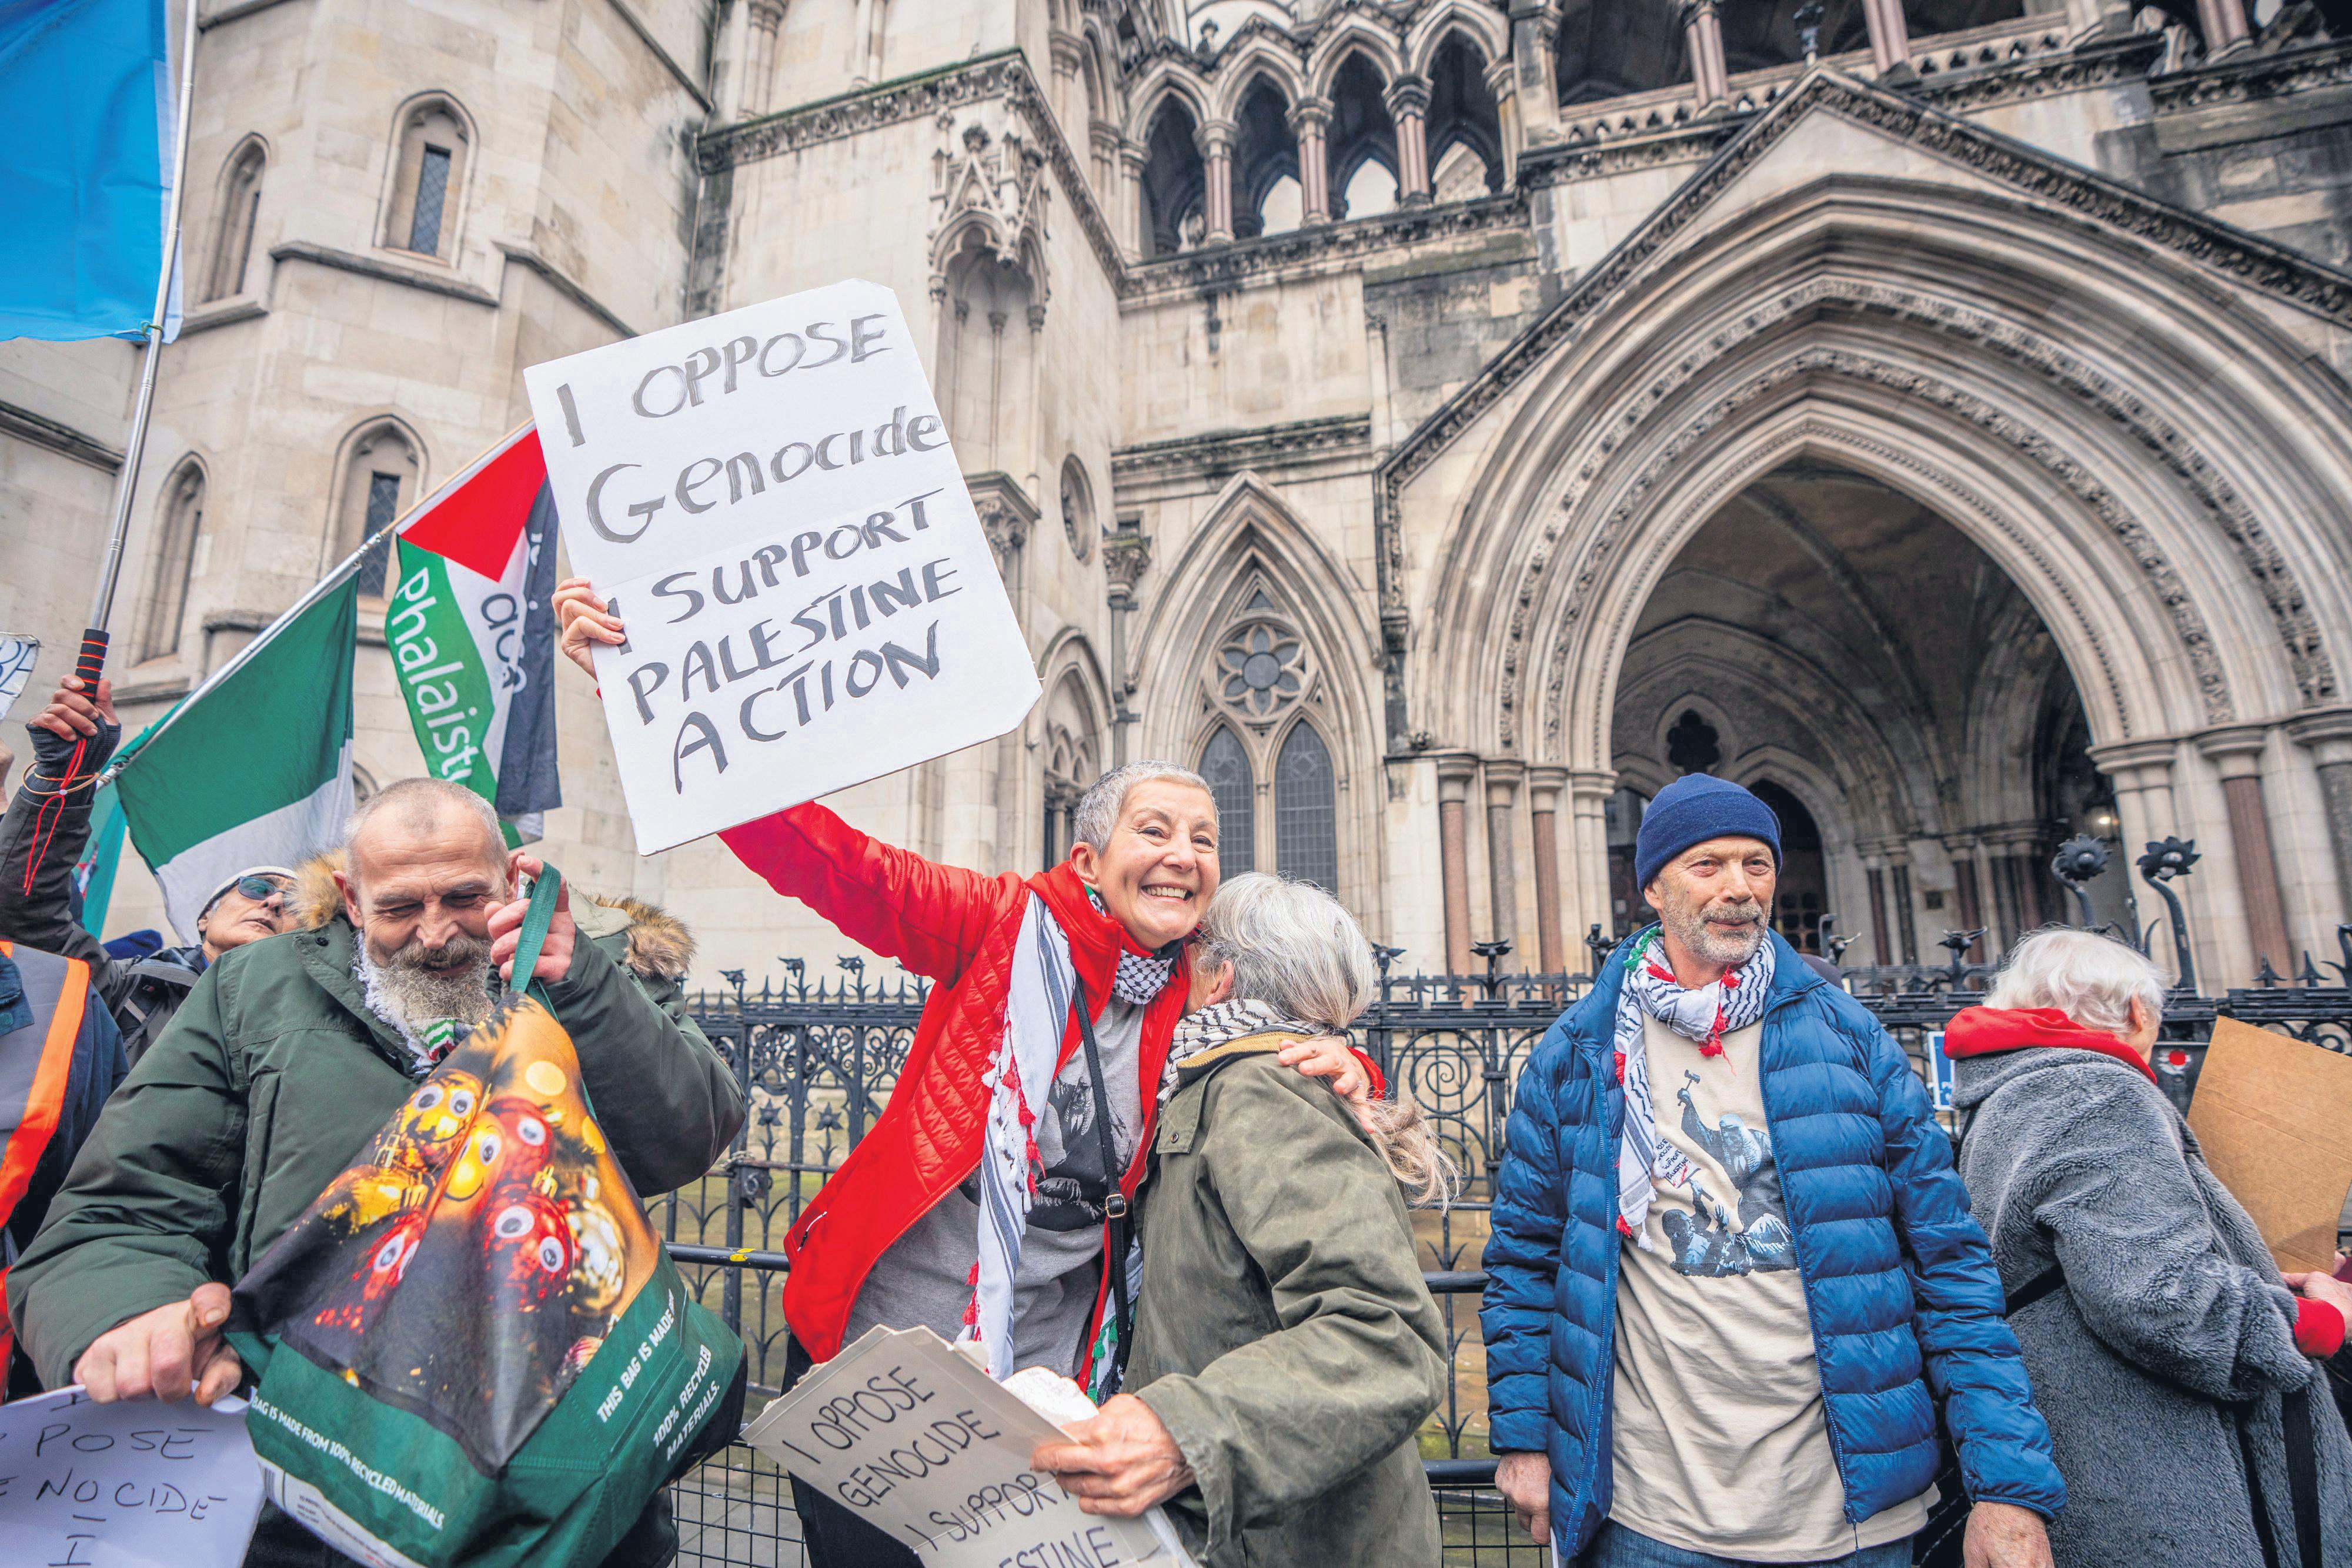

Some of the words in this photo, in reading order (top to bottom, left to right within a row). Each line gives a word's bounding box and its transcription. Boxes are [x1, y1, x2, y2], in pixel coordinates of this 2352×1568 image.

[556, 383, 586, 447] I
[632, 313, 893, 419] OPPOSE
[587, 405, 949, 544] Genocide
[606, 596, 633, 656] I
[651, 487, 945, 624] SUPPORT
[626, 557, 963, 726] PALESTINE
[673, 620, 941, 795] ACTION
[597, 1385, 623, 1423] THIS
[620, 1356, 641, 1390] BAG
[638, 1342, 652, 1362] IS
[649, 1308, 674, 1347] MADE
[653, 1405, 680, 1447] 100%
[679, 1344, 711, 1409] RECYCLED
[782, 1439, 821, 1465] I
[811, 1366, 935, 1450] OPPOSE
[269, 1401, 278, 1420] IS
[278, 1409, 302, 1437] MADE
[301, 1426, 330, 1452] FROM
[329, 1441, 352, 1465] 100%
[350, 1456, 397, 1495] RECYCLED
[667, 1380, 720, 1461] MATERIALS.
[838, 1410, 1001, 1508] GENOCIDE
[905, 1524, 938, 1552] I
